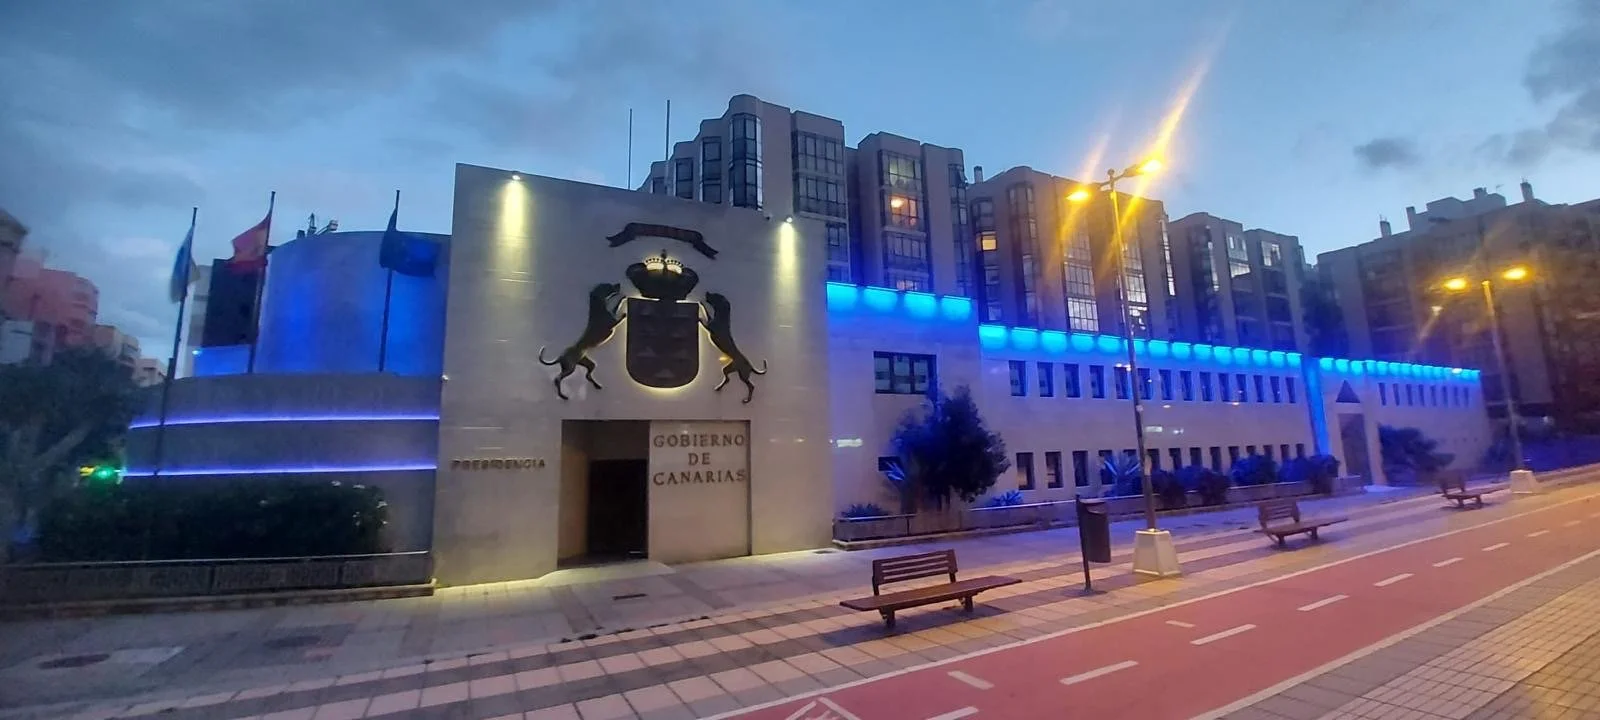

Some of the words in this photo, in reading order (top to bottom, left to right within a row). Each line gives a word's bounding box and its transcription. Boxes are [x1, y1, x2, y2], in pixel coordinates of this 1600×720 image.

[653, 434, 745, 448] GOBIERNO
[451, 458, 545, 471] PRESIDENCIA
[687, 452, 711, 466] DE
[652, 469, 746, 486] CANARIAS
